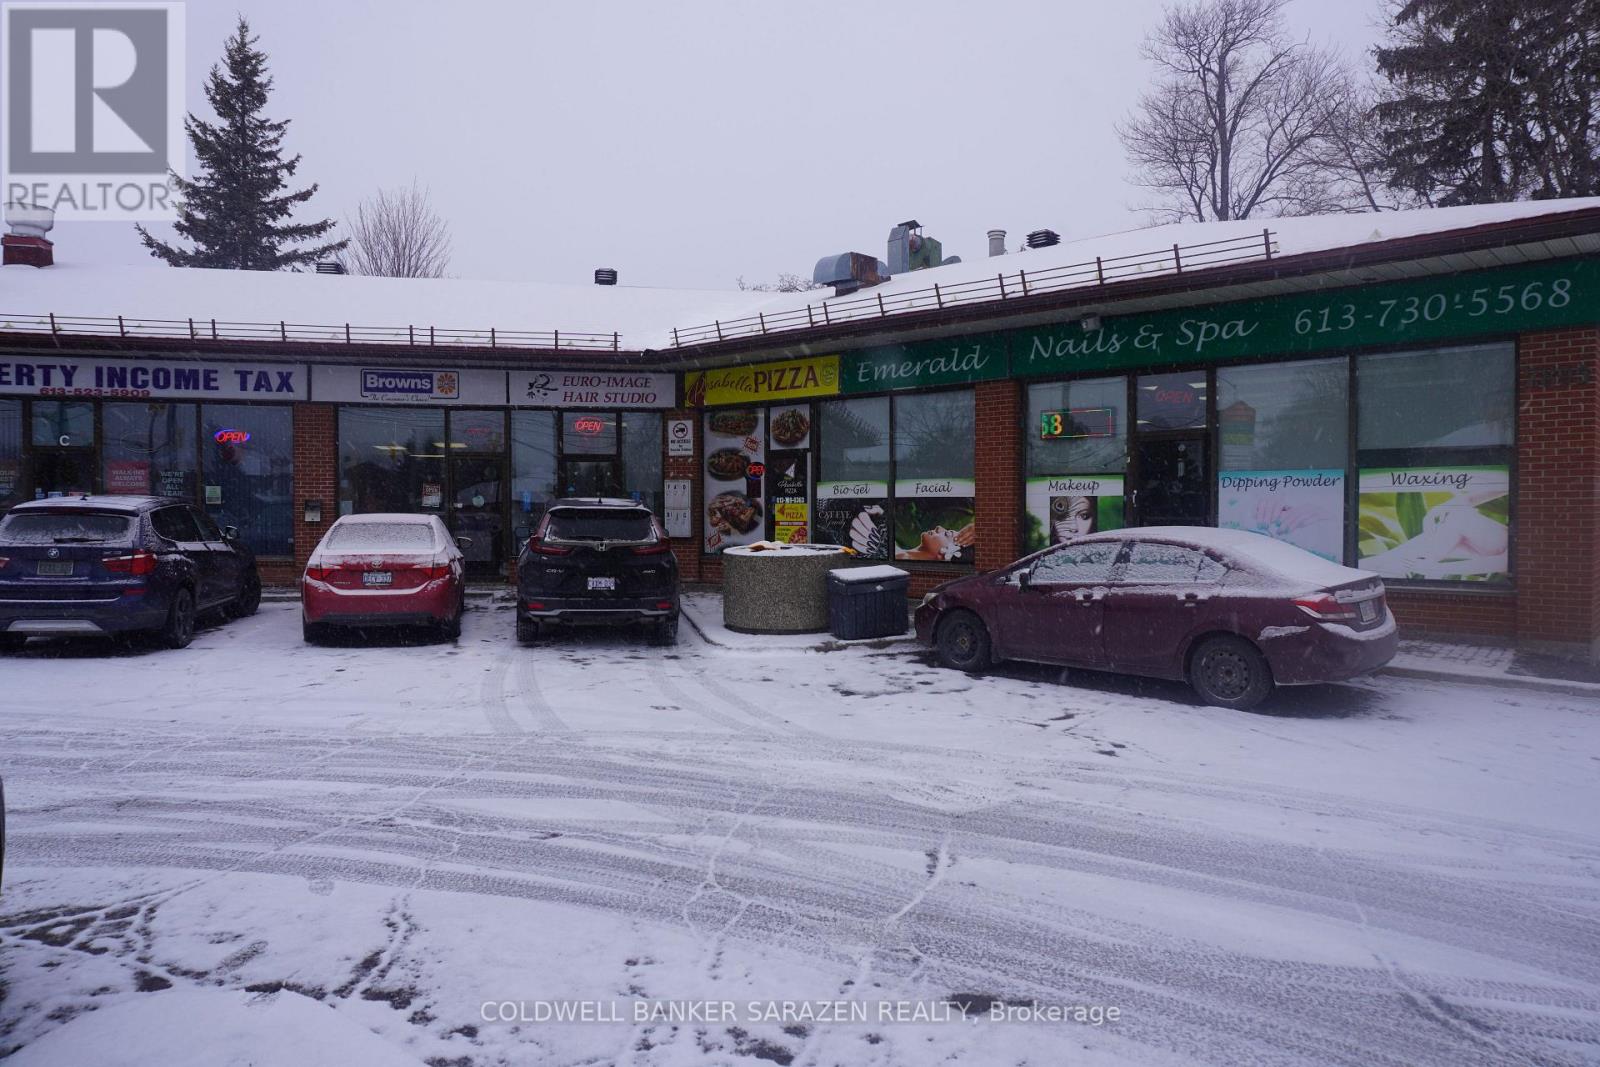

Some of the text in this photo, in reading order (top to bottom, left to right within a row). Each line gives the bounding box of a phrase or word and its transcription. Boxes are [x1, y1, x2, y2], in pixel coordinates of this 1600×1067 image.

[857, 346, 990, 383] Emerald
[1030, 328, 1128, 361] Nails
[1133, 323, 1163, 349] &
[1175, 319, 1260, 352] Spa
[95, 366, 219, 391] INCOME
[234, 370, 294, 393] TAX
[366, 374, 431, 389] Browns
[562, 375, 653, 389] EURO-IMAGE
[753, 365, 820, 393] PIZZA
[562, 391, 657, 404] HAIR STUDIO
[574, 421, 602, 432] OPEN
[59, 434, 70, 446] C
[216, 431, 248, 443] OPEN
[1048, 478, 1100, 494] Makeup
[1221, 473, 1341, 491] Dipping Powder
[1390, 472, 1472, 489] Waxing
[833, 483, 870, 495] Bio-Gel
[915, 482, 952, 495] Facial
[786, 511, 804, 519] PIZZA
